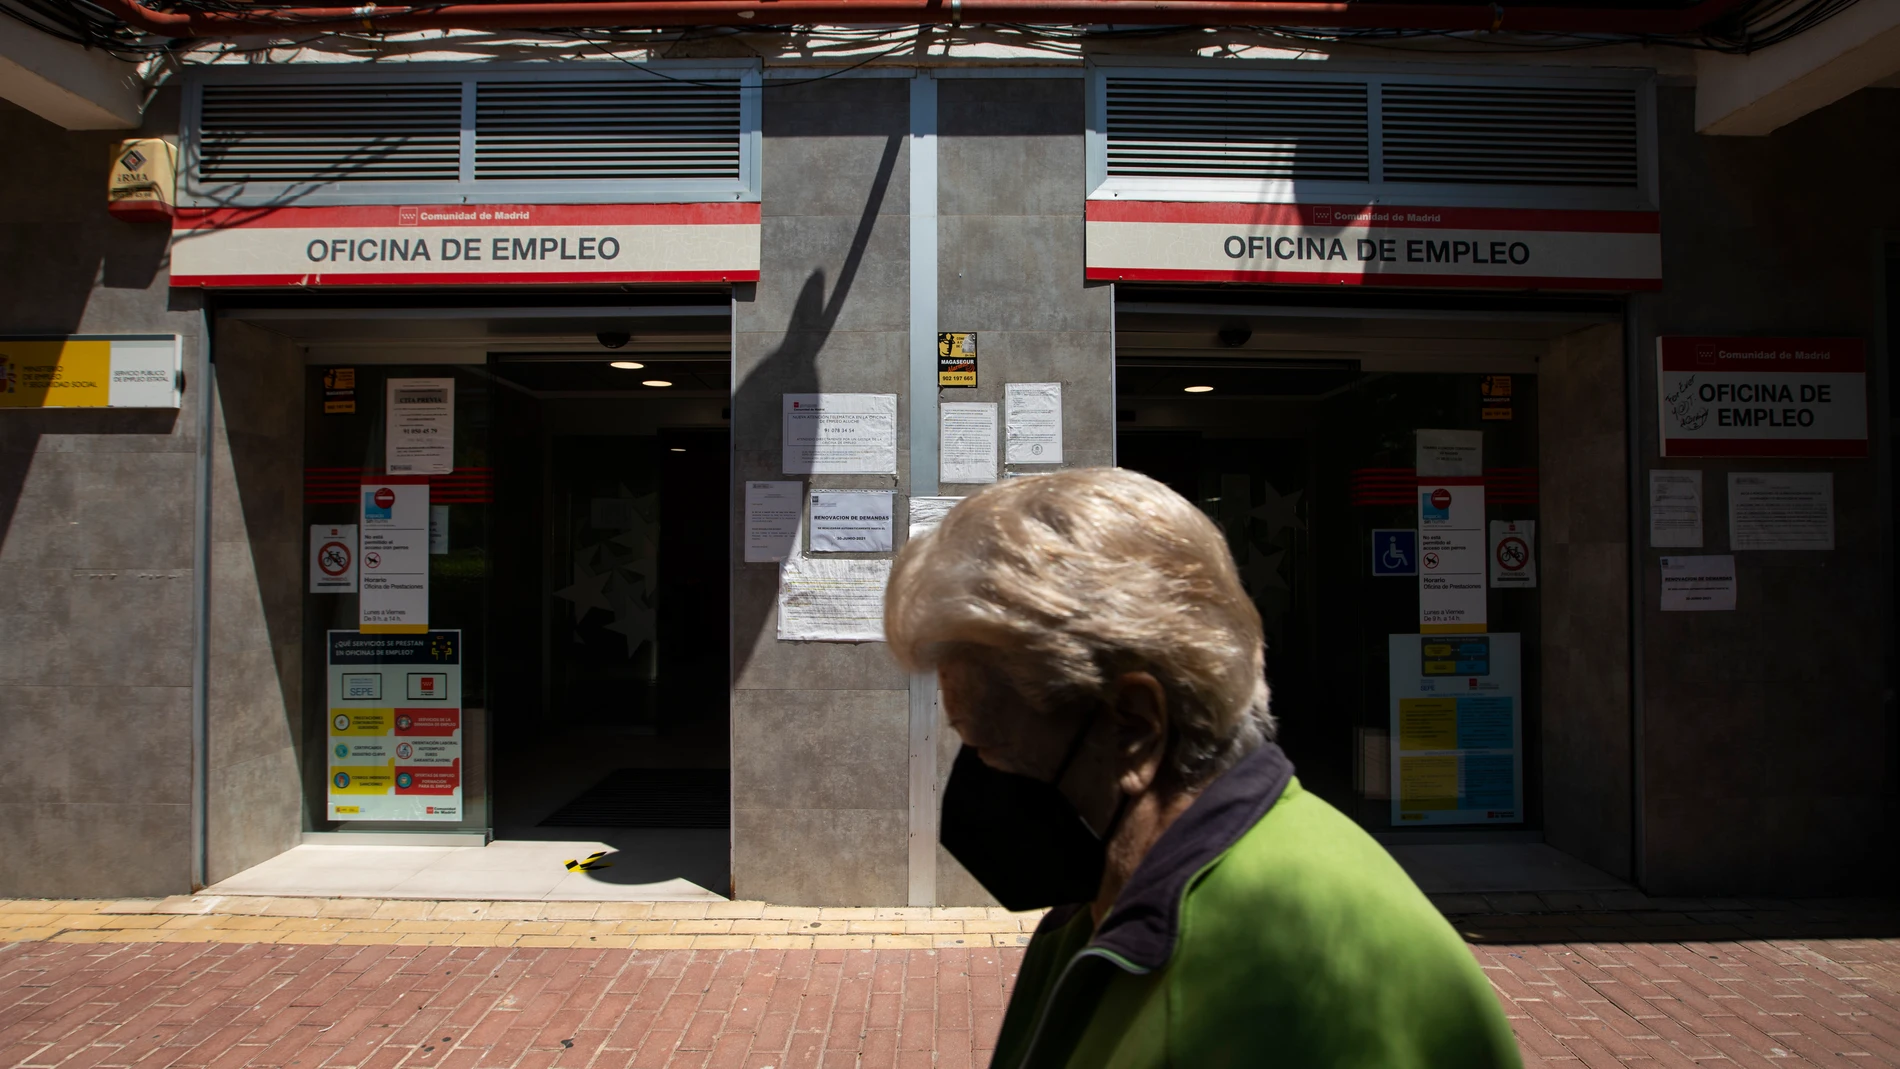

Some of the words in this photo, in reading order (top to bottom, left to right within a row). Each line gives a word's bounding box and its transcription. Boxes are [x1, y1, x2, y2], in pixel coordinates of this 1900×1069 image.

[420, 212, 476, 220] Comunidad
[480, 212, 492, 220] de
[494, 211, 530, 220] Madrid
[1334, 212, 1389, 222] Comunidad
[1392, 212, 1404, 222] de
[1407, 213, 1441, 222] Madrid
[306, 239, 431, 262] OFICINA
[441, 238, 481, 261] DE
[492, 236, 620, 261] EMPLEO
[1224, 235, 1348, 261] OFICINA
[1357, 239, 1396, 262] DE
[1406, 240, 1530, 265] EMPLEO
[1718, 350, 1776, 360] Comunidad
[1780, 350, 1792, 360] de
[1795, 350, 1830, 360] Madrid
[1698, 384, 1794, 402] OFICINA
[1800, 384, 1832, 402] DE
[1718, 408, 1815, 427] EMPLEO
[350, 688, 373, 696] SEPE
